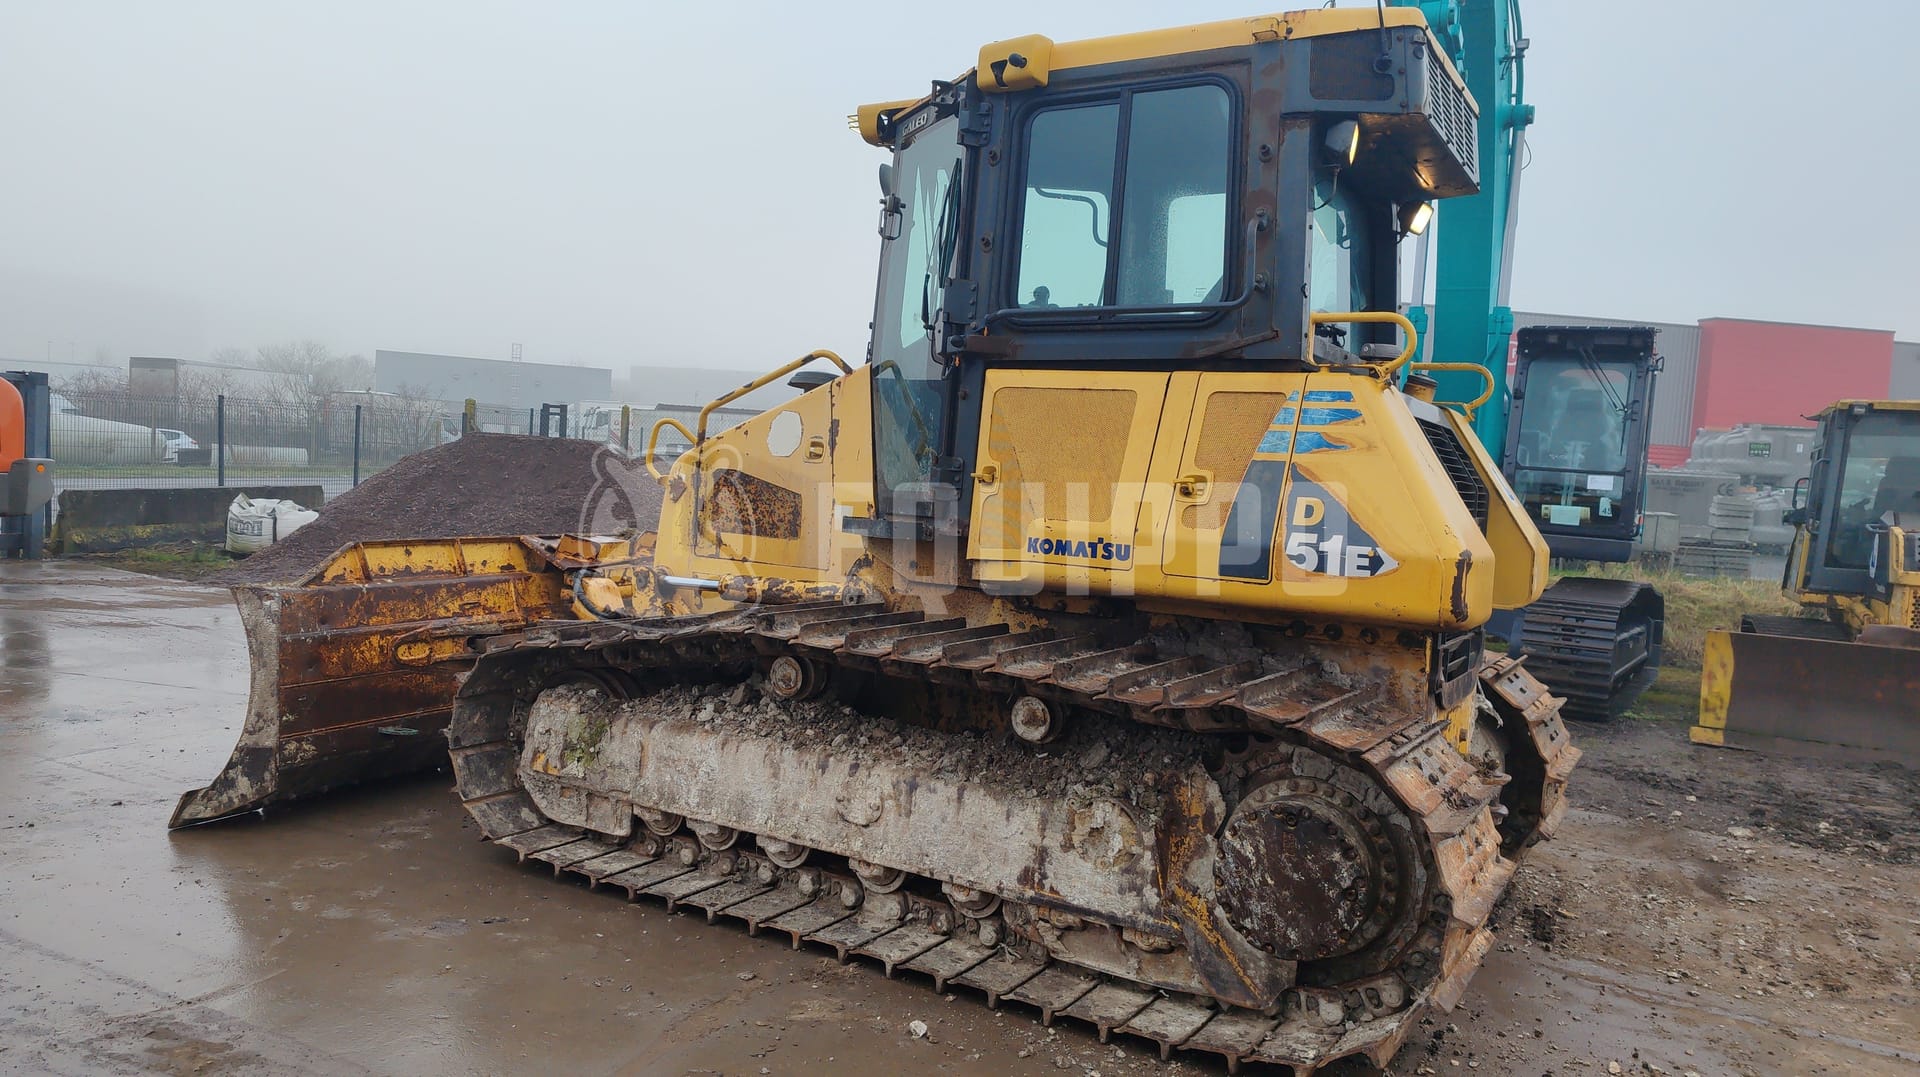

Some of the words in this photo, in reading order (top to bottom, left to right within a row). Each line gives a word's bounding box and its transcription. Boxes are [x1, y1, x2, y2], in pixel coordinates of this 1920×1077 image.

[902, 112, 928, 136] GALEO
[1292, 496, 1325, 527] D
[1027, 537, 1131, 561] KOMATSU
[1285, 532, 1373, 578] 51E
